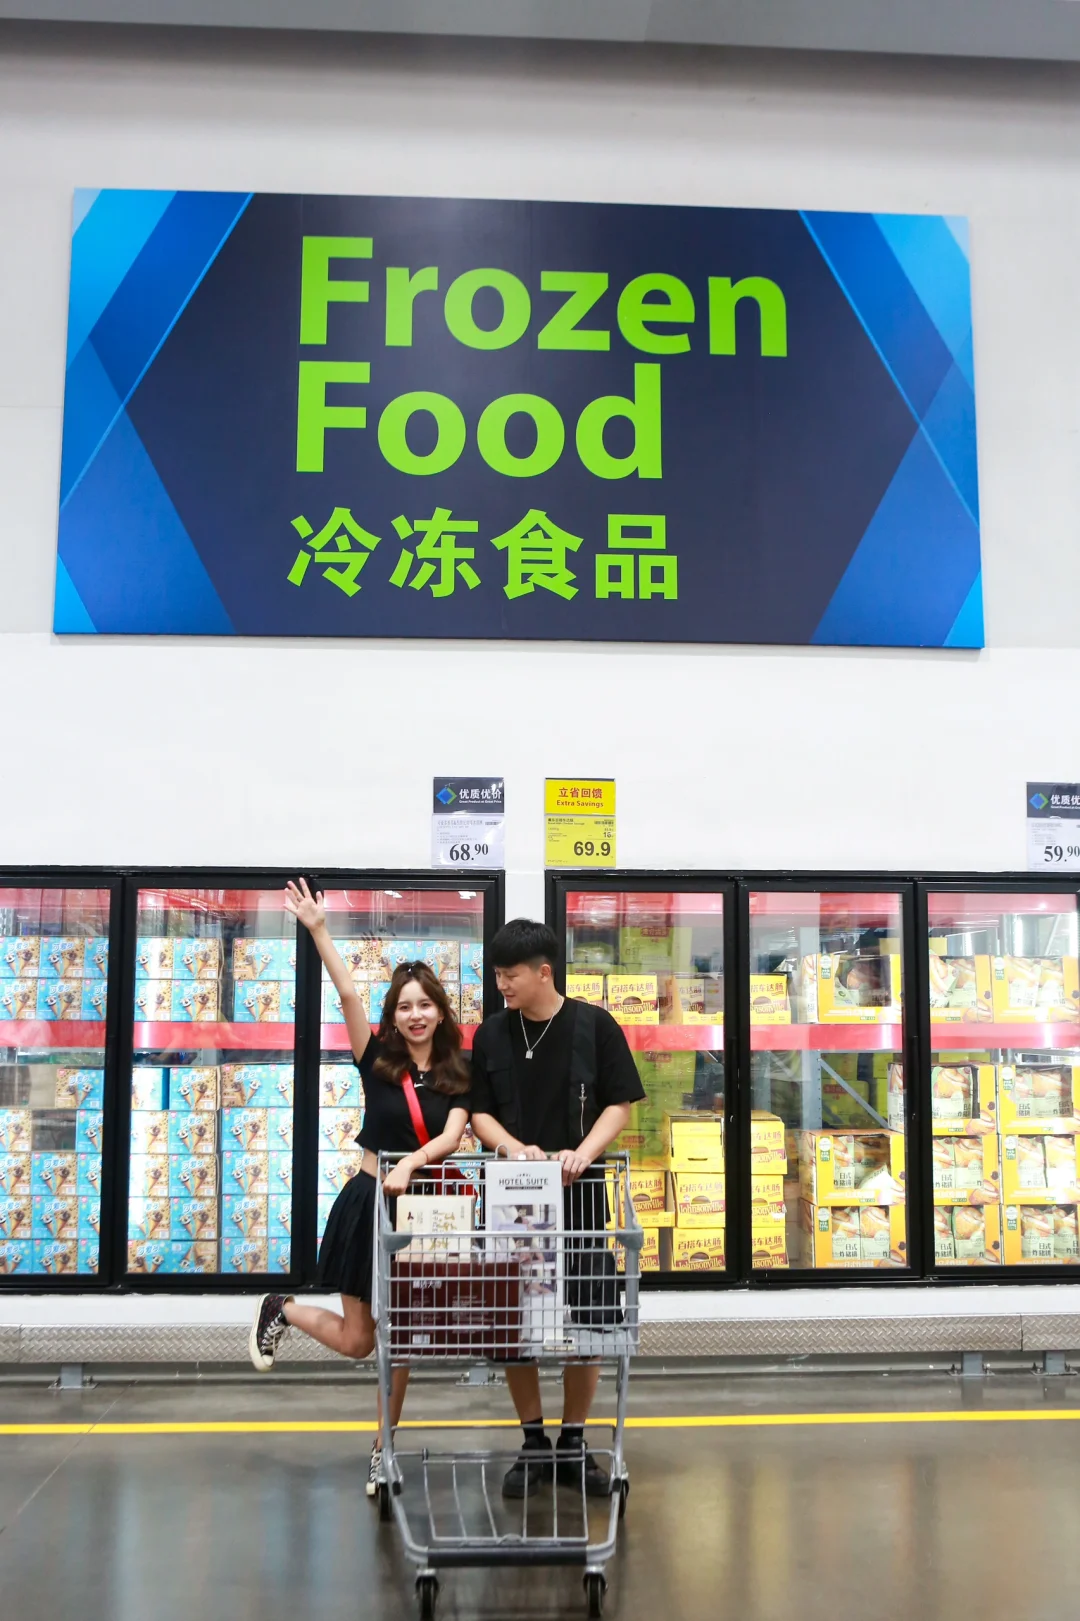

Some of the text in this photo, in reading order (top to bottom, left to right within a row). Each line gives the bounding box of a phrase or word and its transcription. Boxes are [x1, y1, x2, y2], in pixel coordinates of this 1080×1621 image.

[299, 235, 788, 357] Frozen
[296, 360, 664, 479] Food
[286, 506, 678, 600] 冷冻食品
[459, 788, 502, 799] 优质优价
[558, 788, 602, 798] 立省回馈
[1050, 794, 1080, 805] 优质优
[450, 844, 488, 861] 68.90
[574, 841, 610, 856] 69.9
[1044, 846, 1080, 862] 59.90
[567, 982, 600, 992] 搭车达肠
[679, 1202, 724, 1214] Johnsonville
[678, 1237, 721, 1250] 百搭车达肠
